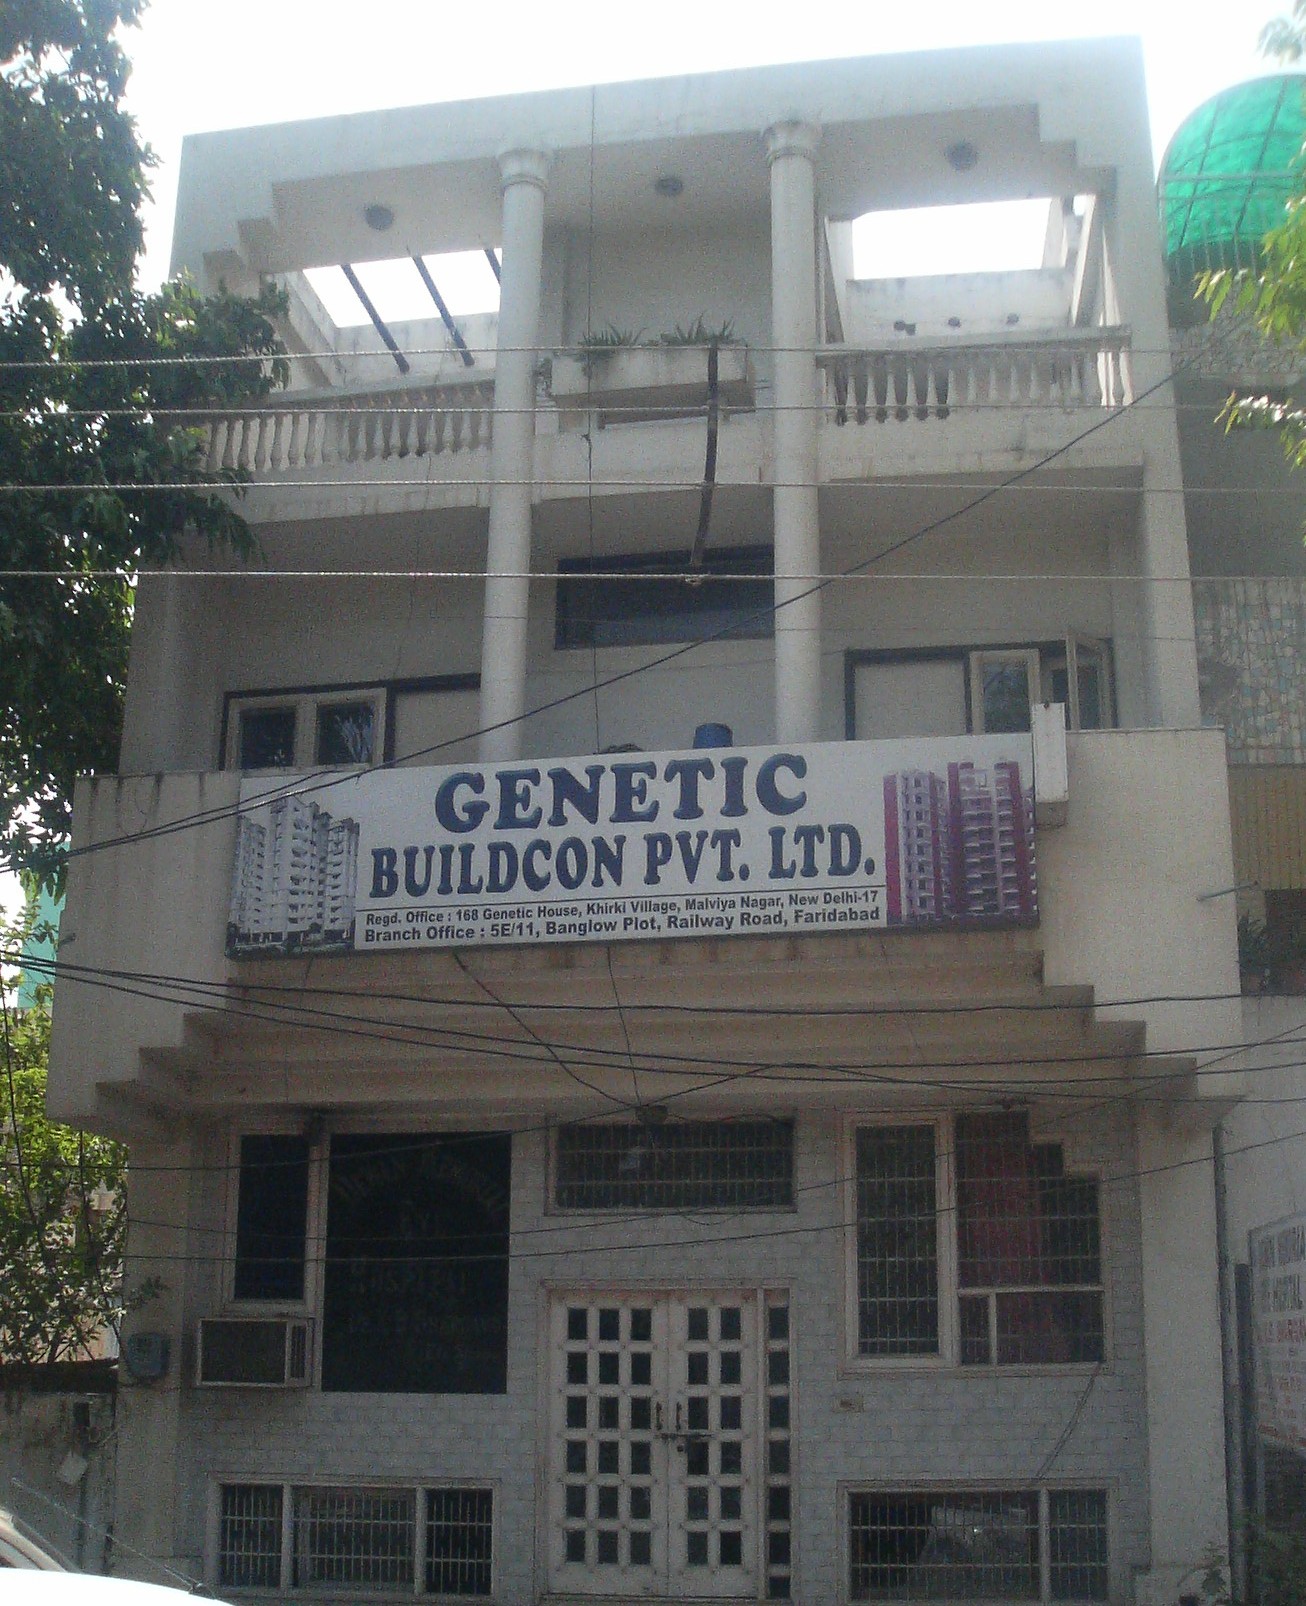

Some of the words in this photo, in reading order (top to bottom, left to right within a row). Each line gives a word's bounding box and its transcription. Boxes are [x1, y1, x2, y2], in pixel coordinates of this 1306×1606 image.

[434, 753, 807, 834] GENETIC
[368, 834, 626, 898] BUILDCON
[643, 828, 750, 885] PVT.
[768, 823, 876, 880] LTD.
[365, 928, 421, 943] Branch
[426, 925, 475, 940] Office
[490, 922, 540, 938] 5E/11,
[545, 918, 618, 937] Banglow
[623, 916, 661, 932] Plot,
[667, 913, 734, 930] Railway
[740, 910, 788, 927] Road,
[793, 907, 880, 923] Faridabad
[366, 912, 402, 927] Regd.
[406, 911, 444, 923] Office
[456, 910, 479, 921] 168
[483, 906, 533, 920] Genetic
[538, 904, 582, 919] House,
[586, 901, 626, 915] Khirki
[630, 900, 681, 915] Village,
[685, 897, 736, 912] Malviya
[740, 895, 784, 910] Nagar,
[789, 893, 819, 906] New
[823, 890, 878, 904] Delhi-17
